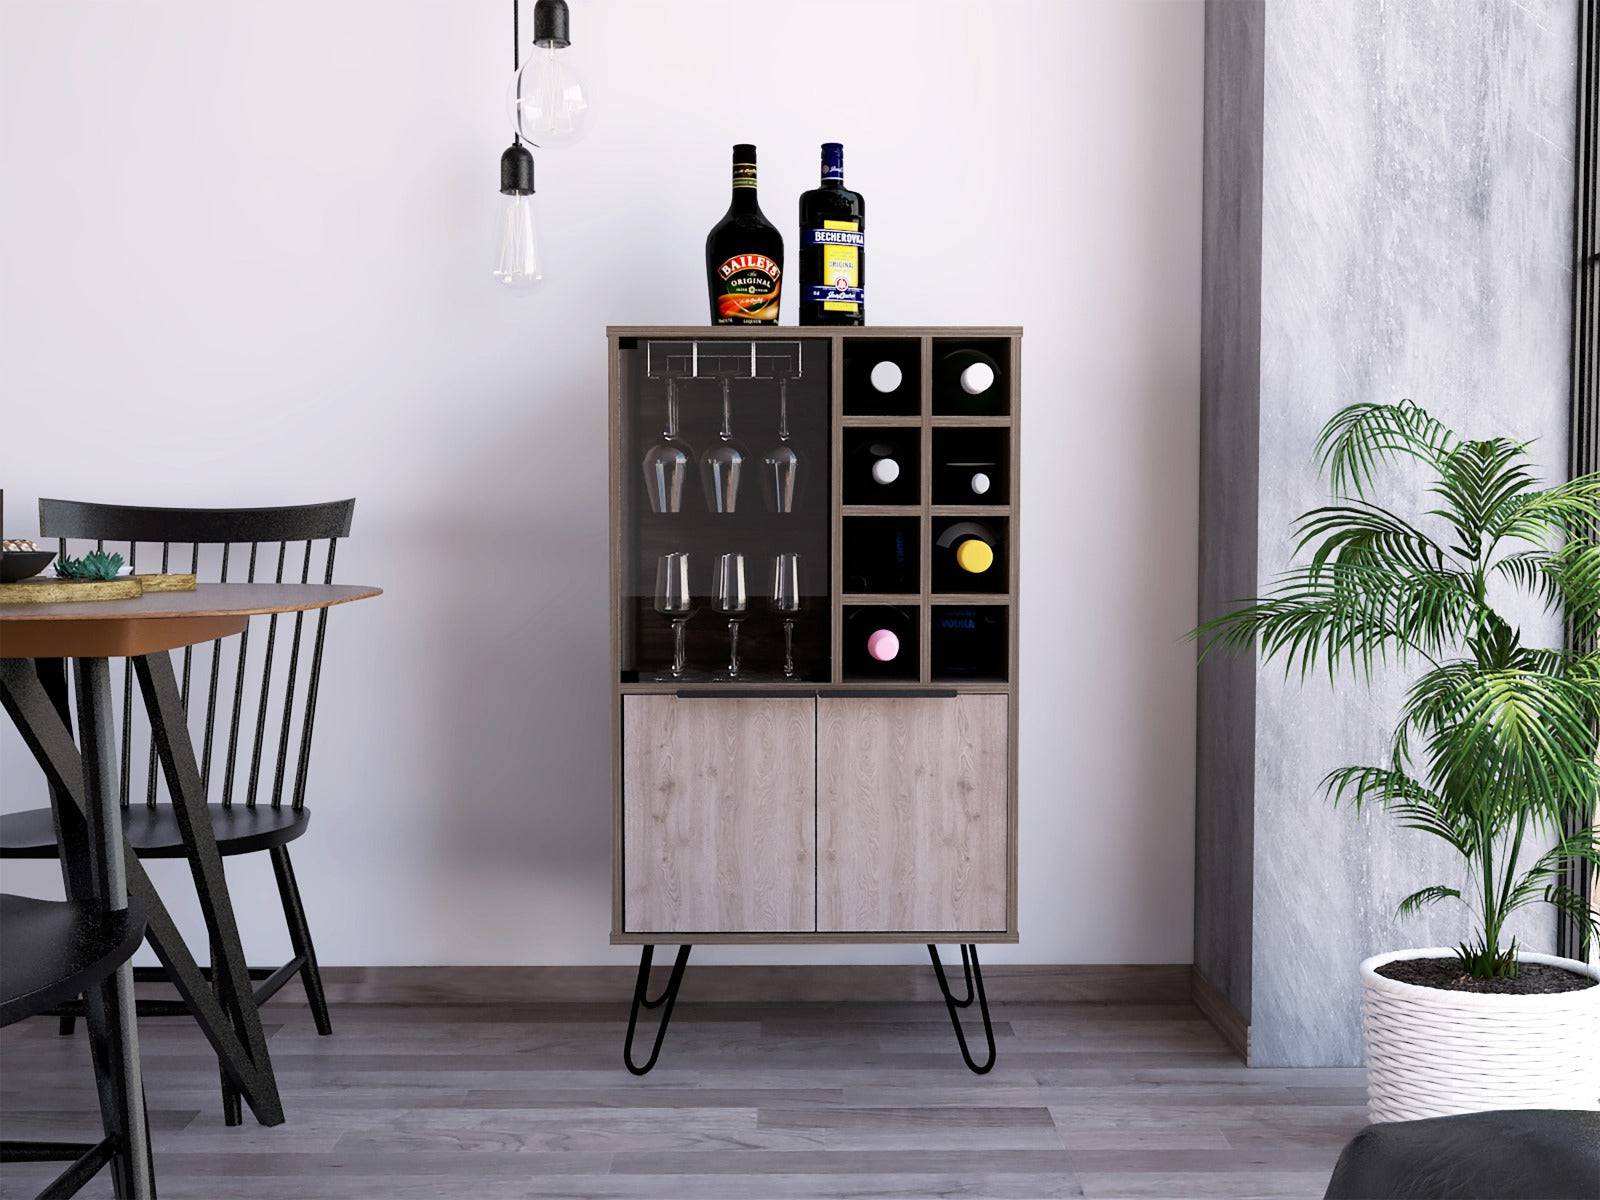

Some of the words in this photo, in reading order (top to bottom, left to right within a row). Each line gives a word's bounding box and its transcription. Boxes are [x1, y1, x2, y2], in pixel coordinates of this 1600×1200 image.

[814, 231, 864, 244] BECHEROVKA
[721, 256, 778, 276] BAILEYS
[731, 278, 771, 288] ORIGINAL
